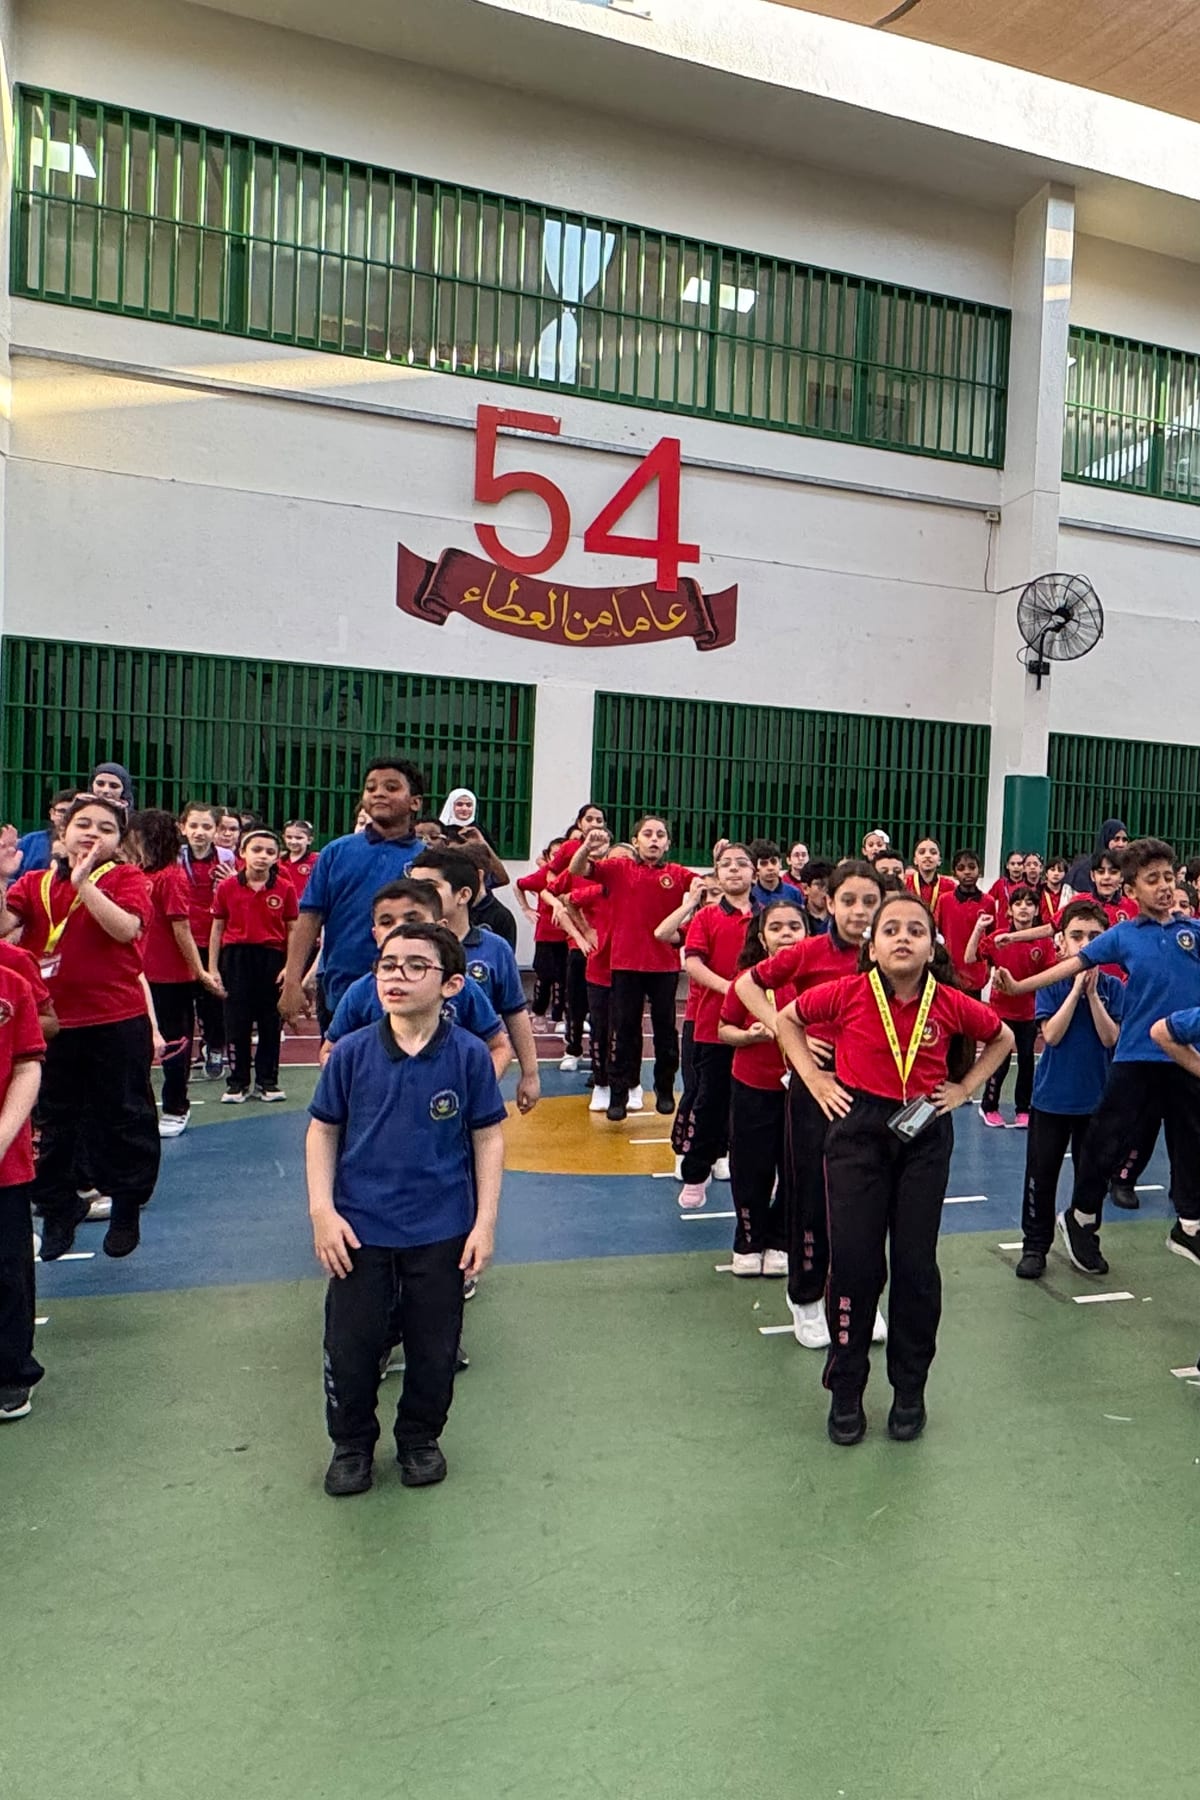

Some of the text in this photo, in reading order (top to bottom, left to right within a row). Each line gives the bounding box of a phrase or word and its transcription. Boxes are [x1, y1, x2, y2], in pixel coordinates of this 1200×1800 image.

[474, 404, 700, 592] 54
[459, 569, 569, 631] العطاء
[564, 609, 613, 642] من
